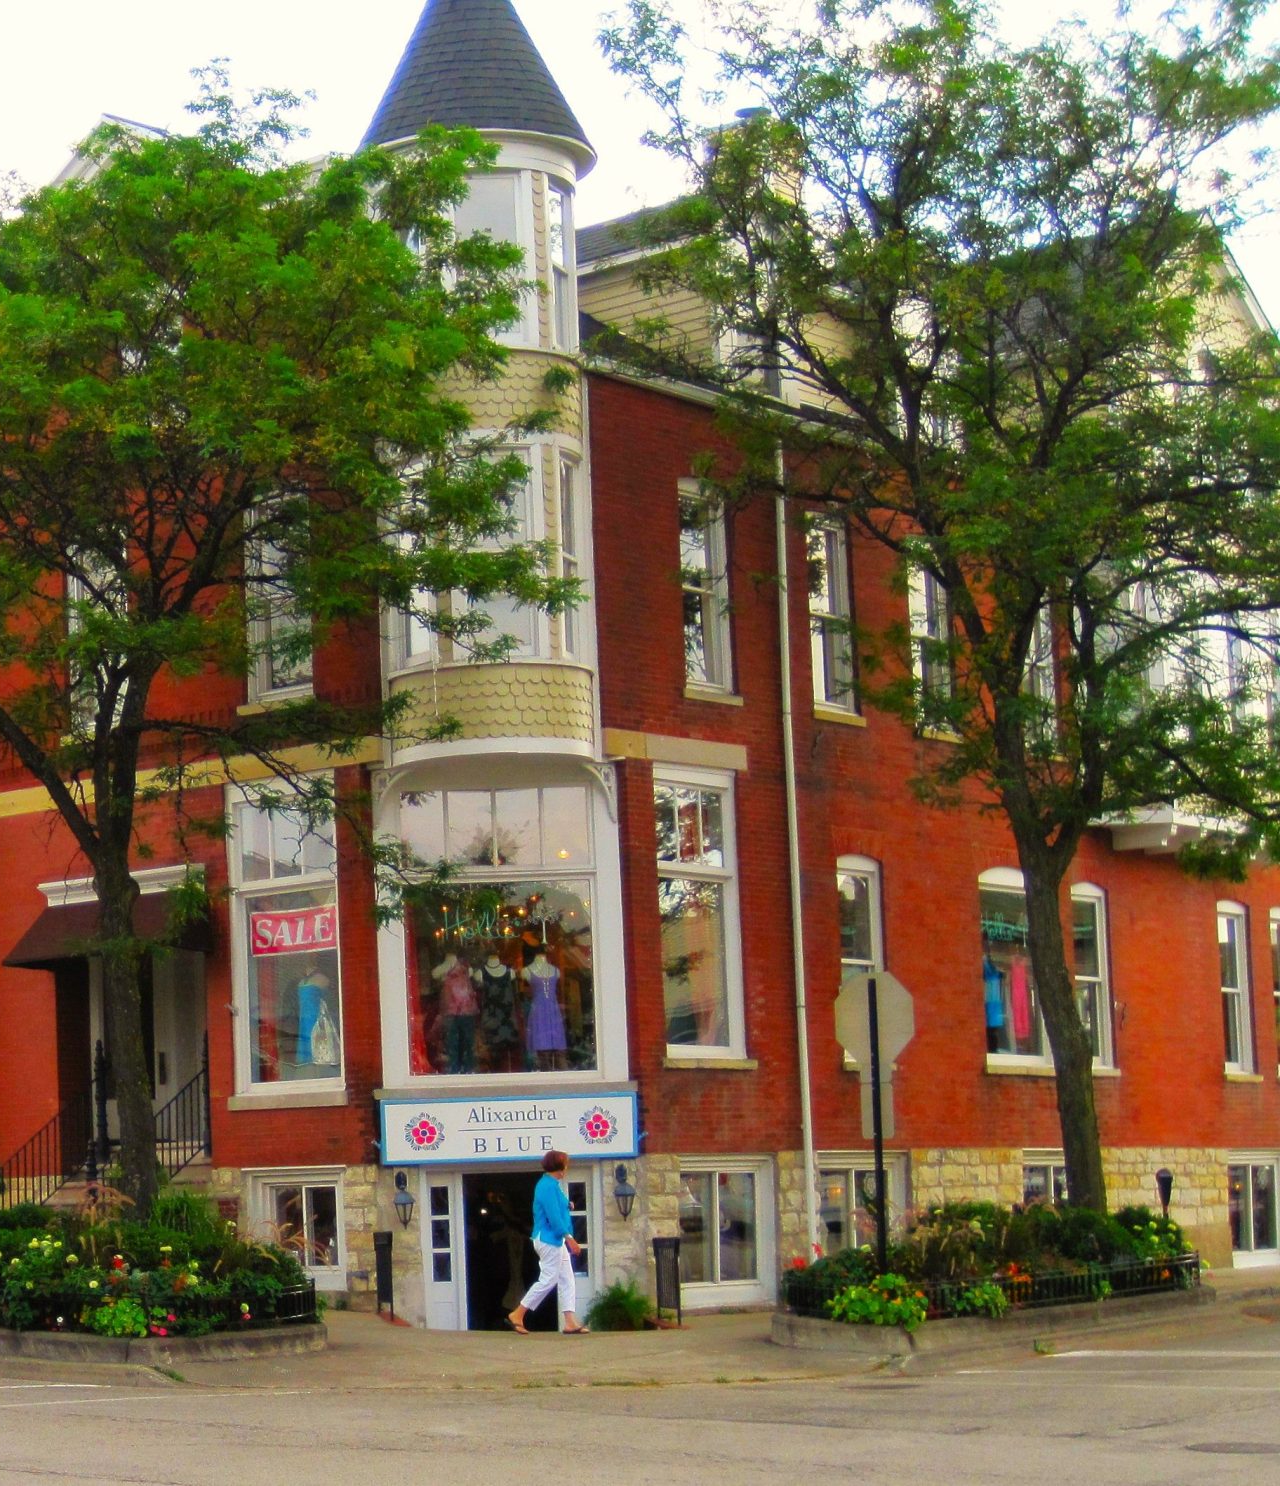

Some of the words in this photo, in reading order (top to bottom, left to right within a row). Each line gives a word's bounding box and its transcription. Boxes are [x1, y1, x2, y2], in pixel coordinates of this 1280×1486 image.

[256, 912, 333, 949] SALE
[467, 1105, 557, 1124] Alixandra
[473, 1135, 554, 1154] BLUE
